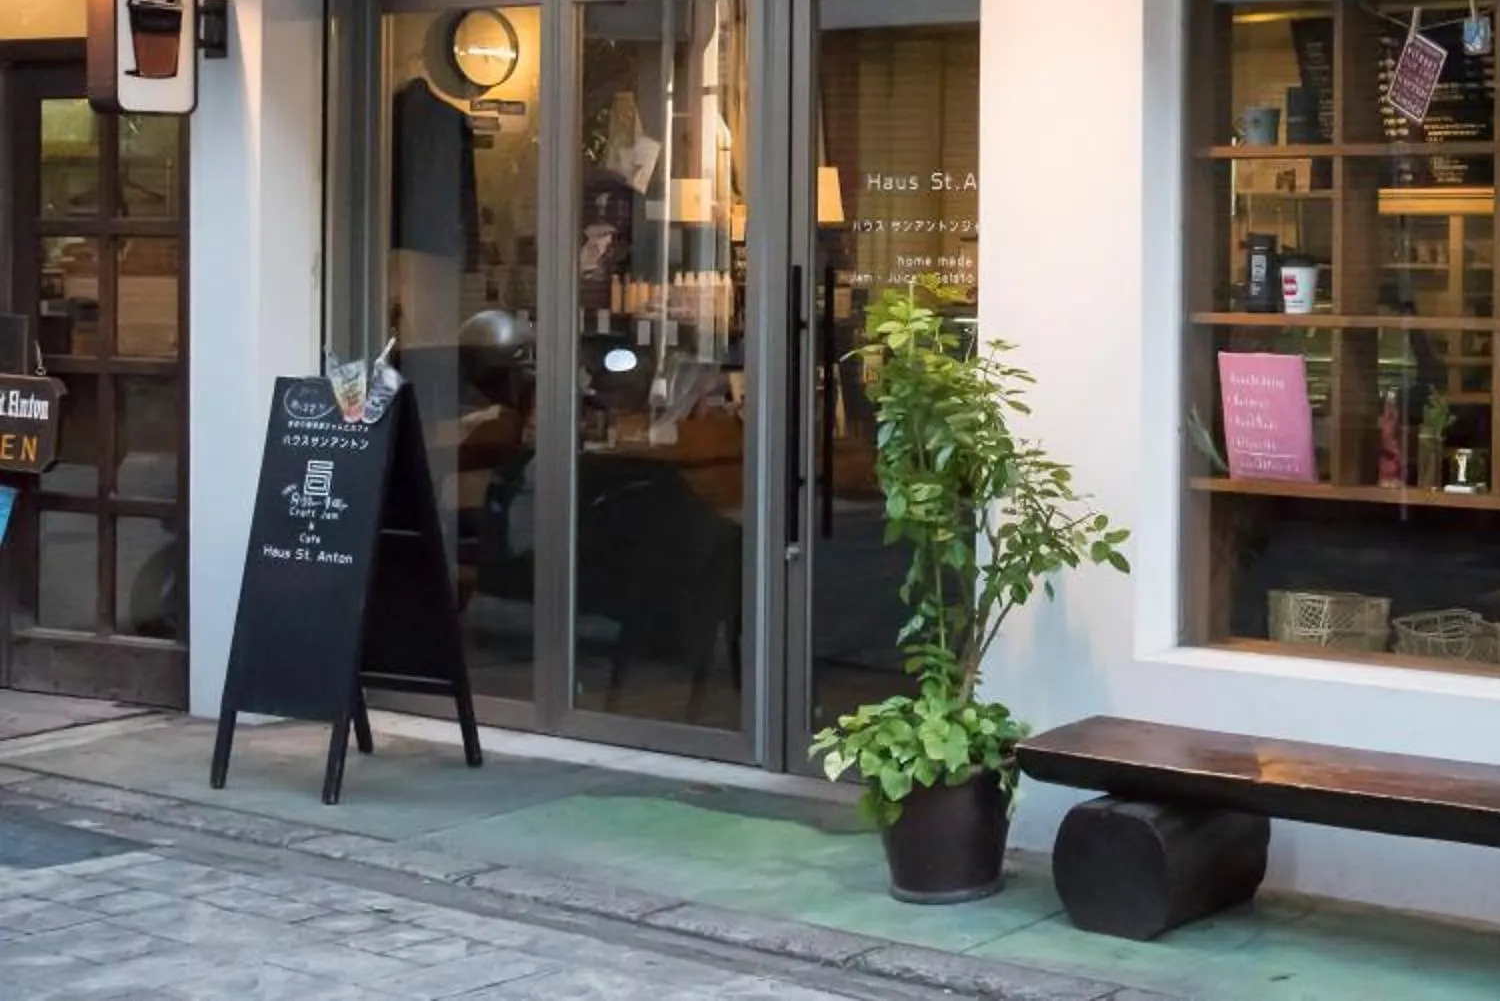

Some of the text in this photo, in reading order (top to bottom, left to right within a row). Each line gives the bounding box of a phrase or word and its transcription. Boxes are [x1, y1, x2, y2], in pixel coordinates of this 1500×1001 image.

[866, 172, 919, 191] Haus
[8, 390, 49, 420] Anton
[263, 545, 292, 560] Haus
[316, 550, 354, 565] Anton
